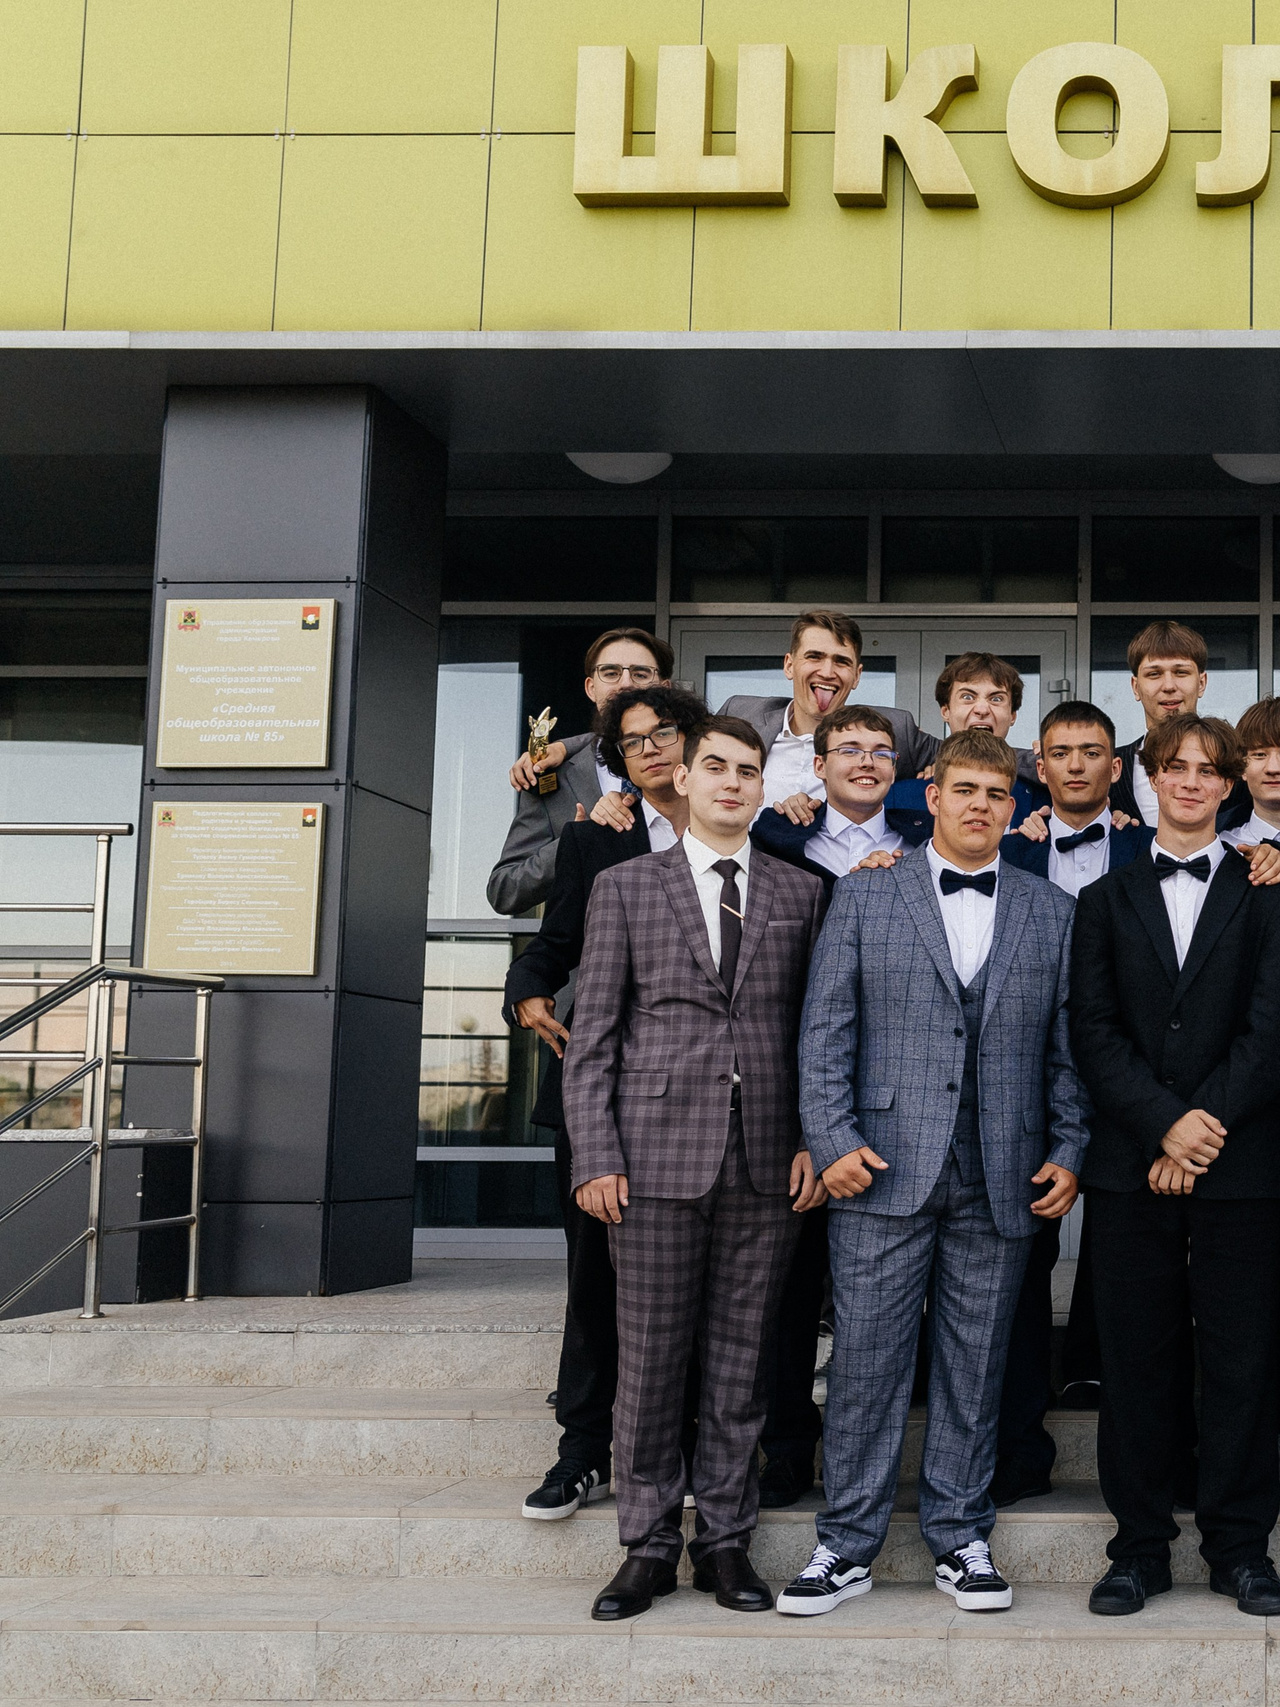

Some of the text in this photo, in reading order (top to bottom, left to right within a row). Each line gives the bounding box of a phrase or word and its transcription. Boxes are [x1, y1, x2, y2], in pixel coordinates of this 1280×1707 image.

[176, 664, 317, 674] Муниципальное автономное
[189, 674, 302, 684] общеобразовательное
[215, 686, 275, 695] учреждение
[212, 703, 276, 715] «Средняя
[166, 717, 321, 729] общеобразовательная
[199, 731, 285, 742] школа № 85»
